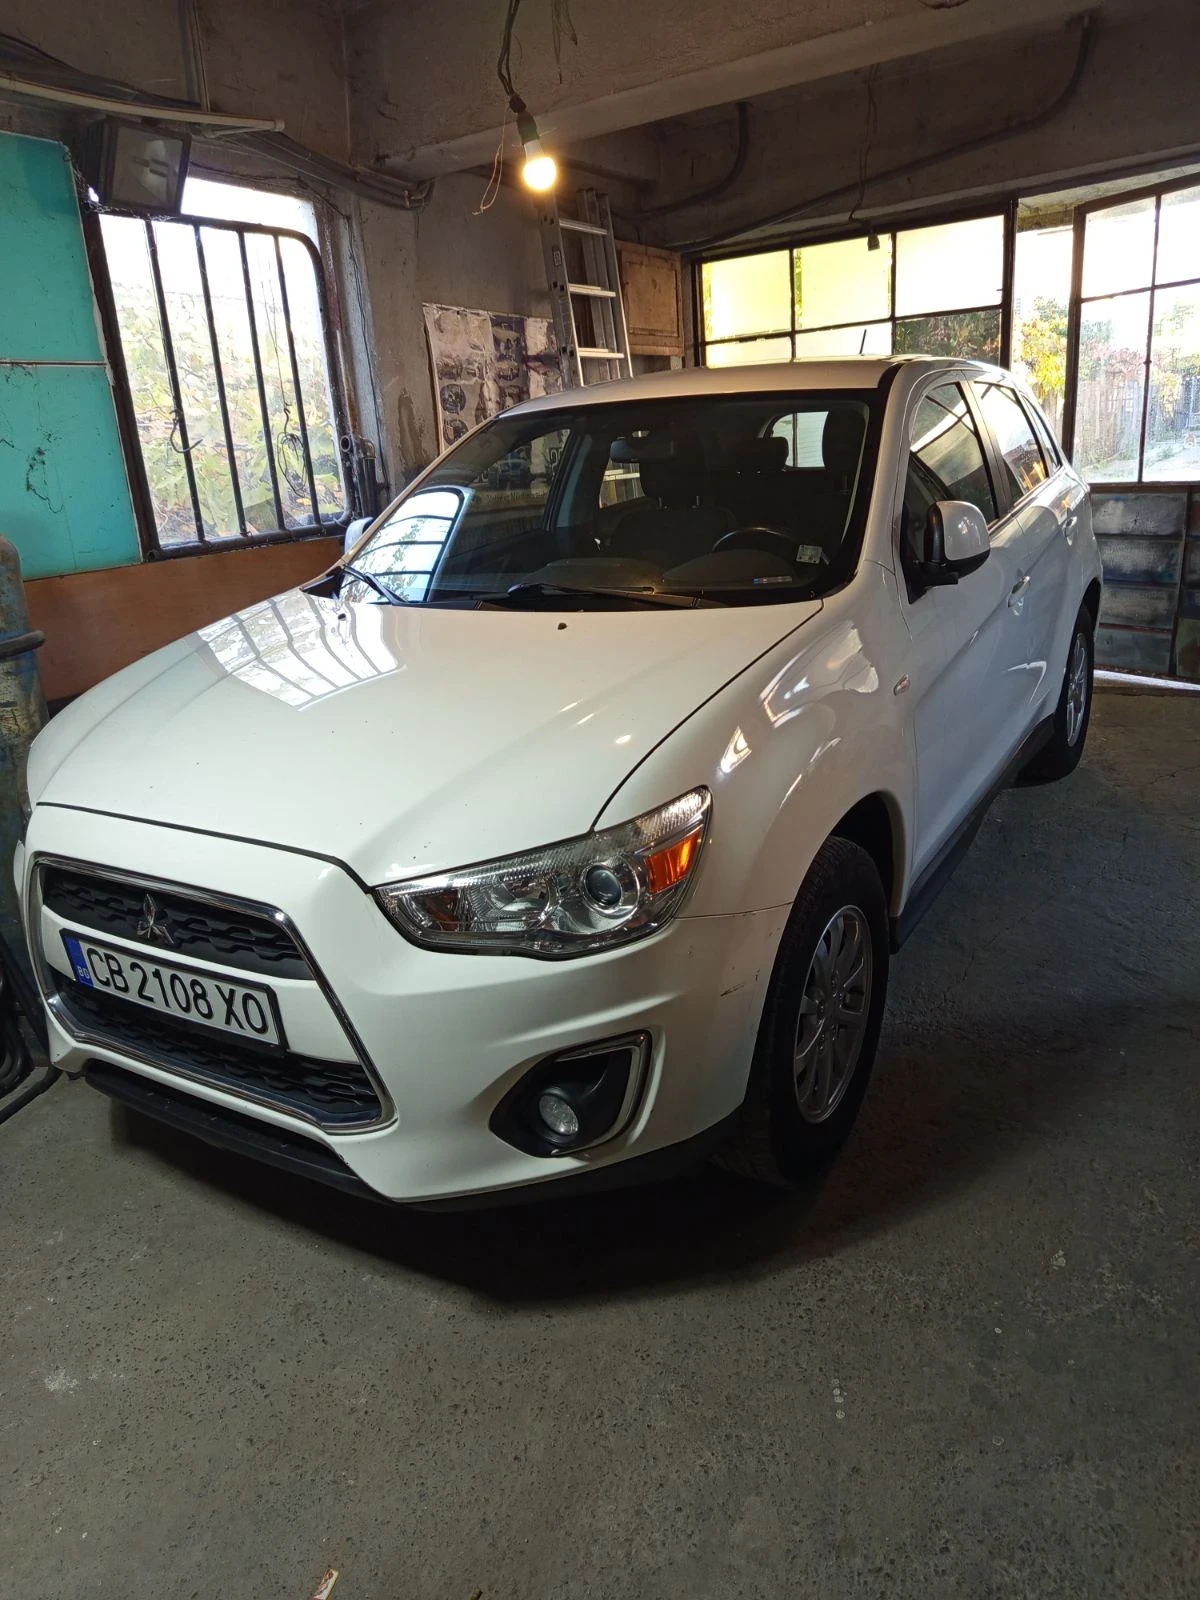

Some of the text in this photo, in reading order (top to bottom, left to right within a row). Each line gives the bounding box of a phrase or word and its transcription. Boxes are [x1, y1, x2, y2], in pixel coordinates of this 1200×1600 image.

[77, 965, 90, 979] BG
[87, 948, 268, 1034] CB 2108 XO
